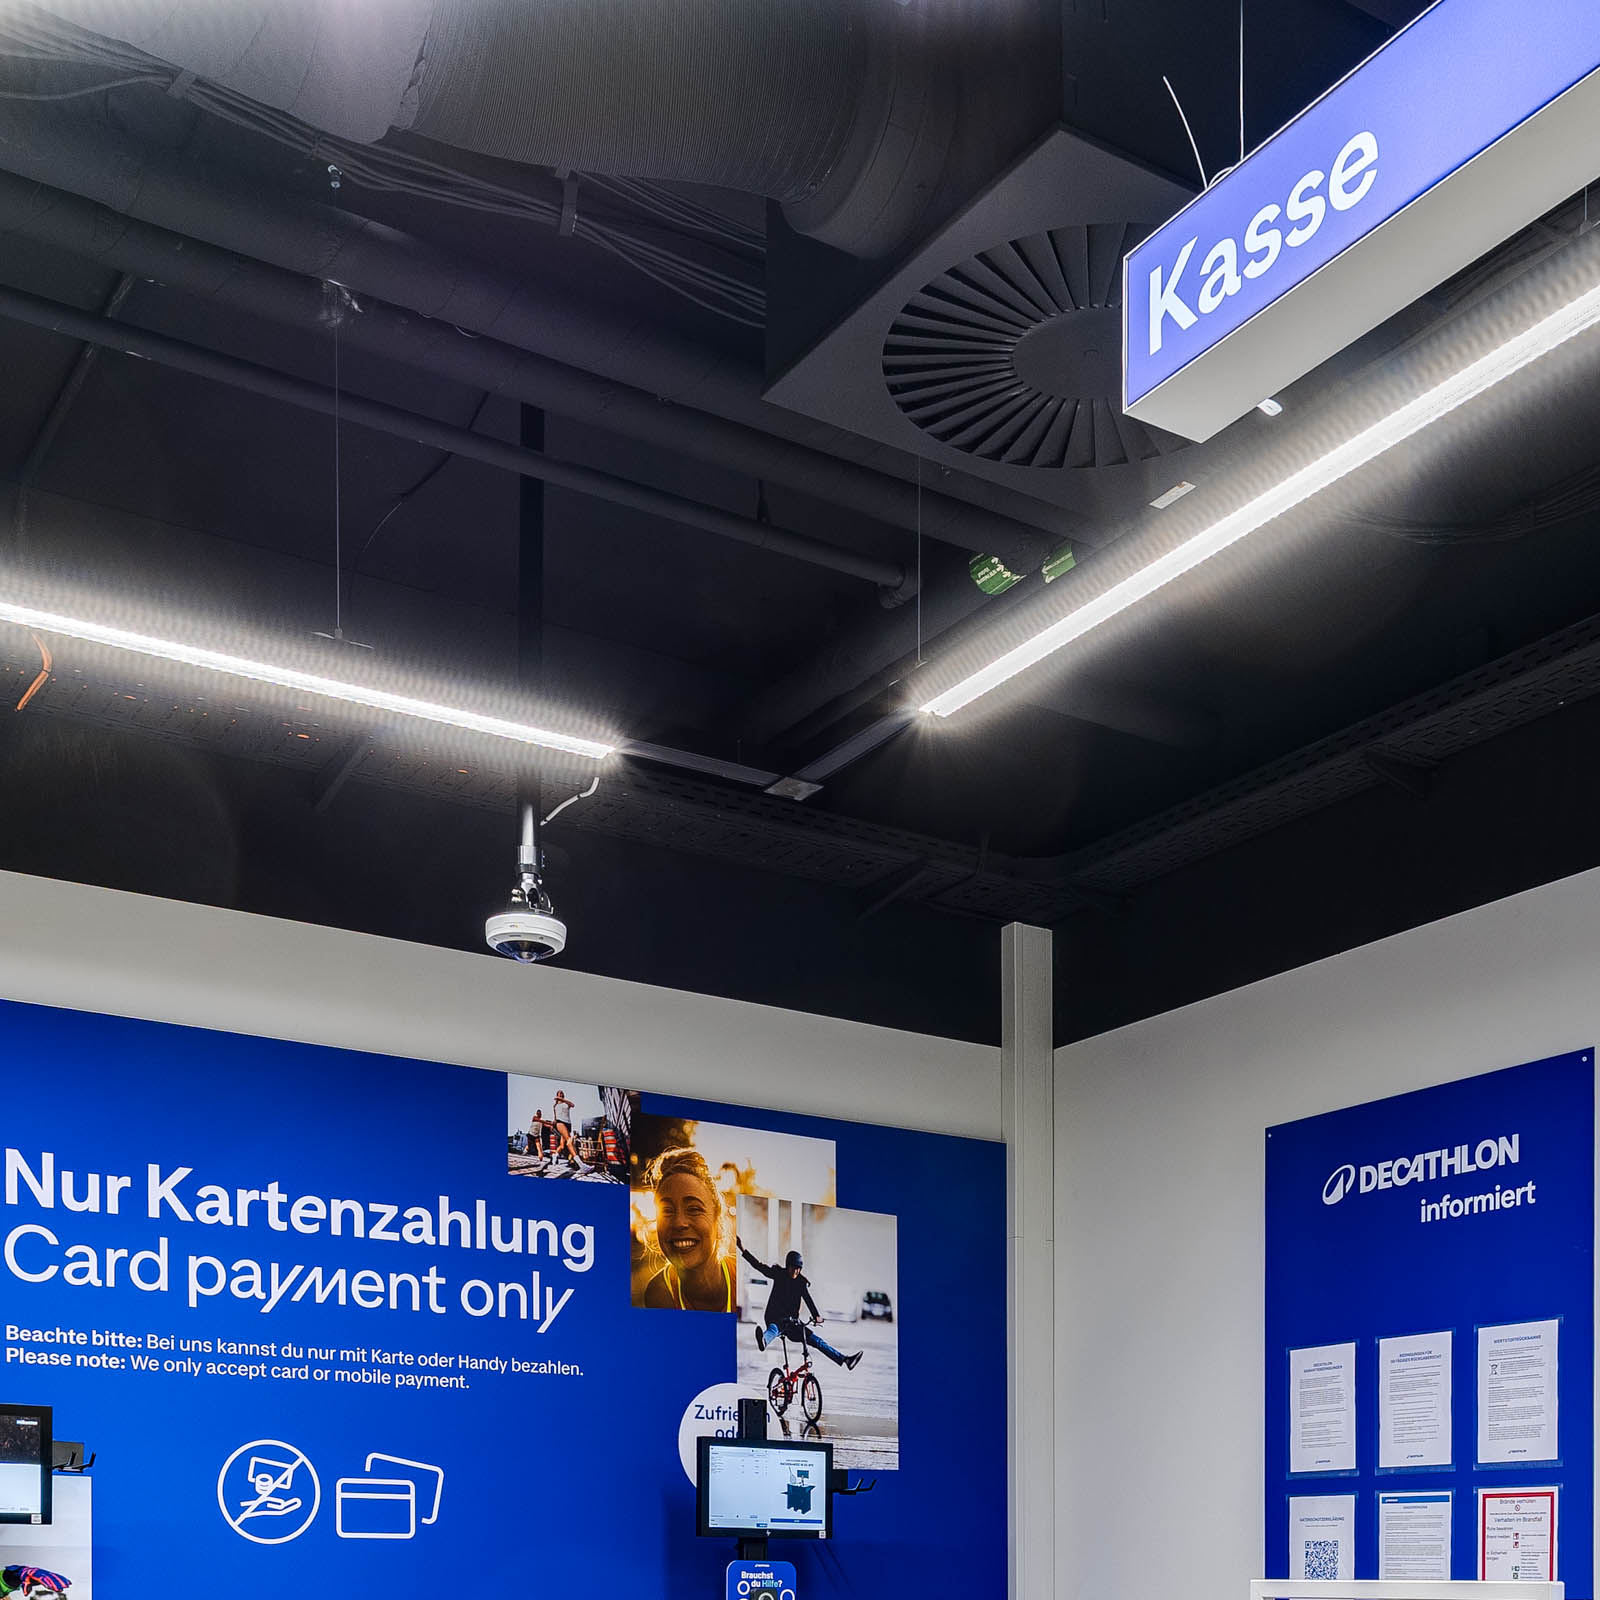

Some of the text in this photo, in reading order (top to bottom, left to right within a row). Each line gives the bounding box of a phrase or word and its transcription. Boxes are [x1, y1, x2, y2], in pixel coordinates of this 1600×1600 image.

[1150, 130, 1379, 356] Kasse
[1359, 1133, 1520, 1194] DECATHLON
[5, 1147, 596, 1272] Nur Kartenzahlung
[1420, 1180, 1537, 1223] informiert
[4, 1223, 575, 1333] Card payment only
[5, 1324, 585, 1376] Beachte bitte: Bei uns kannst du nur mit Karte oder Handy bezahlen.
[5, 1347, 470, 1389] Please note: We only accept card or mobile payment.
[741, 1571, 774, 1580] Brauchst
[751, 1580, 783, 1588] du Hilfe?
